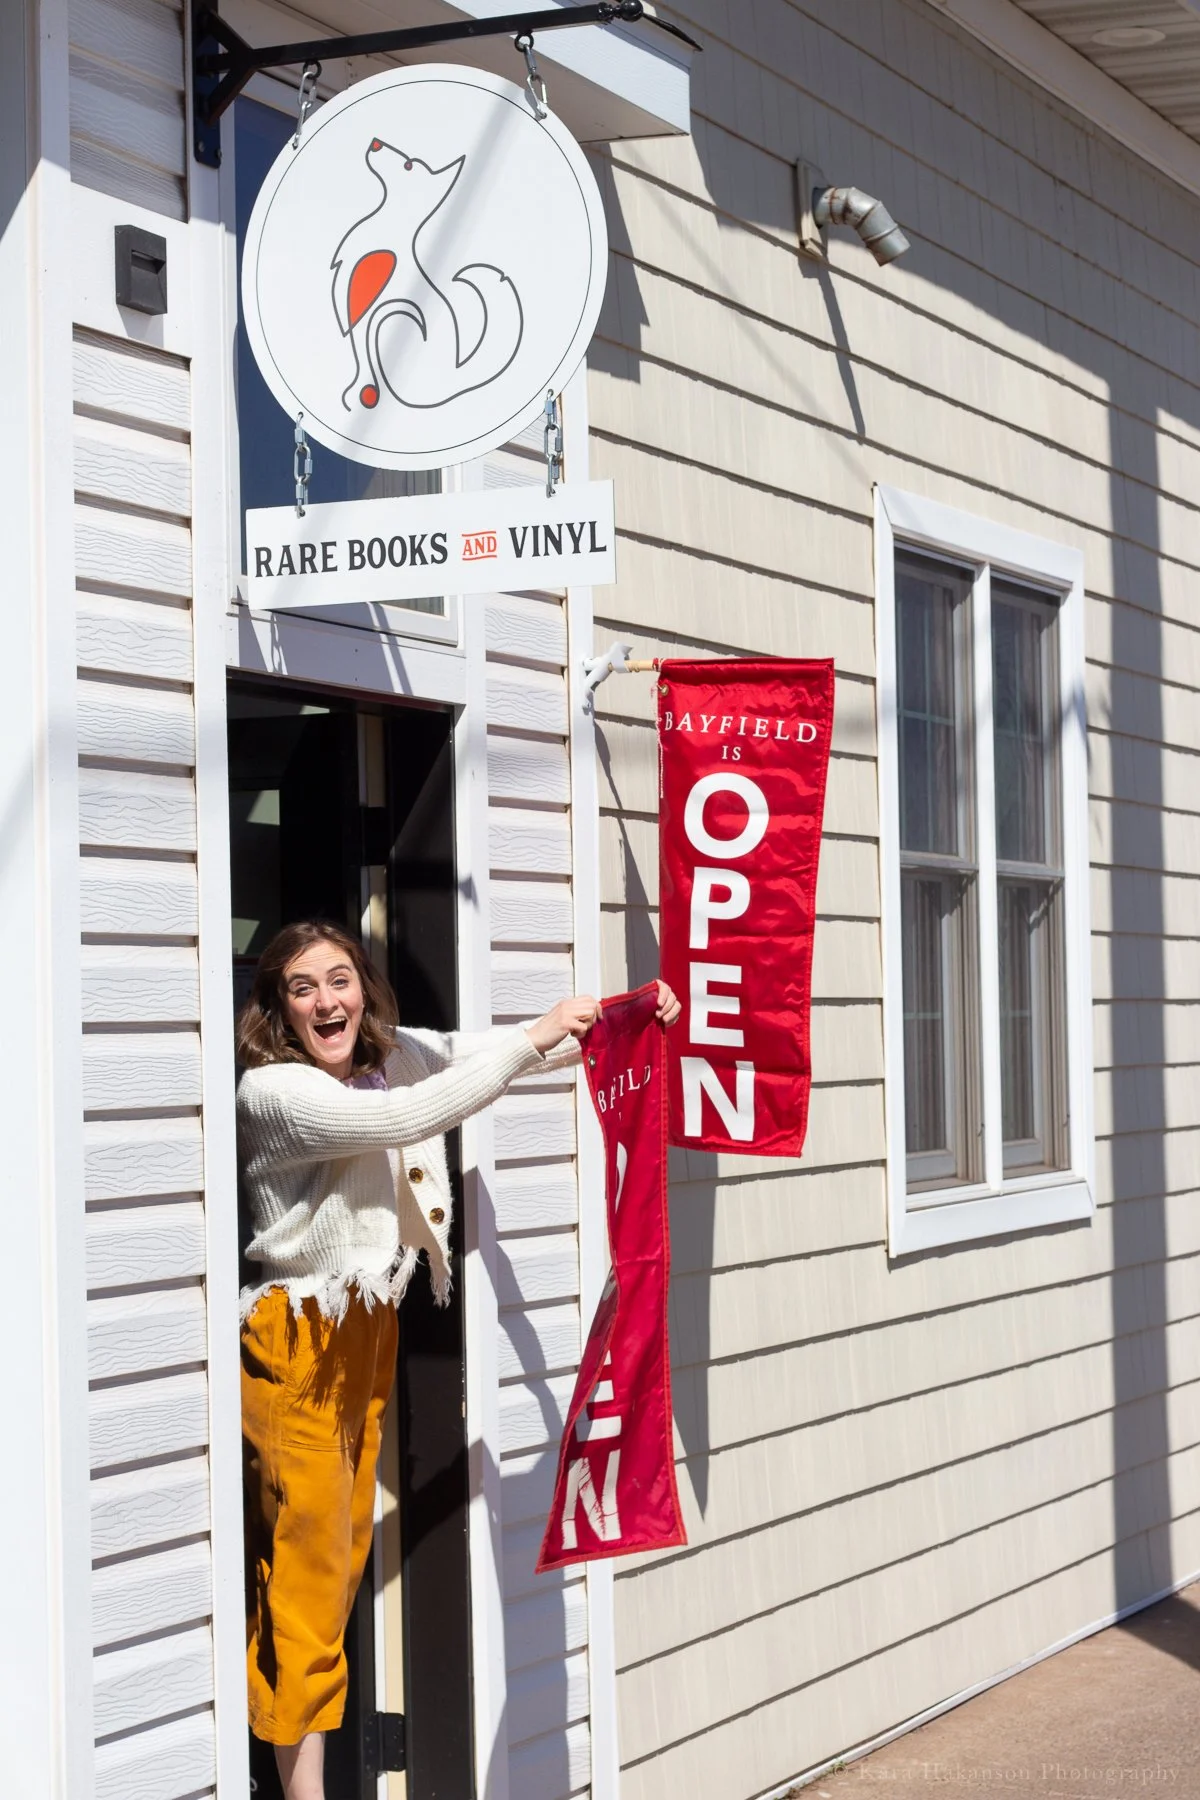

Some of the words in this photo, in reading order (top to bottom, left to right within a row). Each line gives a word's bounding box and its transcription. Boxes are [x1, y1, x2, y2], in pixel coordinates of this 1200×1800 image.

[254, 541, 338, 578] RARE
[348, 532, 448, 571] BOOKS
[462, 533, 497, 558] AND
[508, 520, 607, 558] VINYL
[665, 711, 817, 743] BAYFIELD
[721, 745, 742, 760] IS
[680, 772, 770, 1142] OPEN
